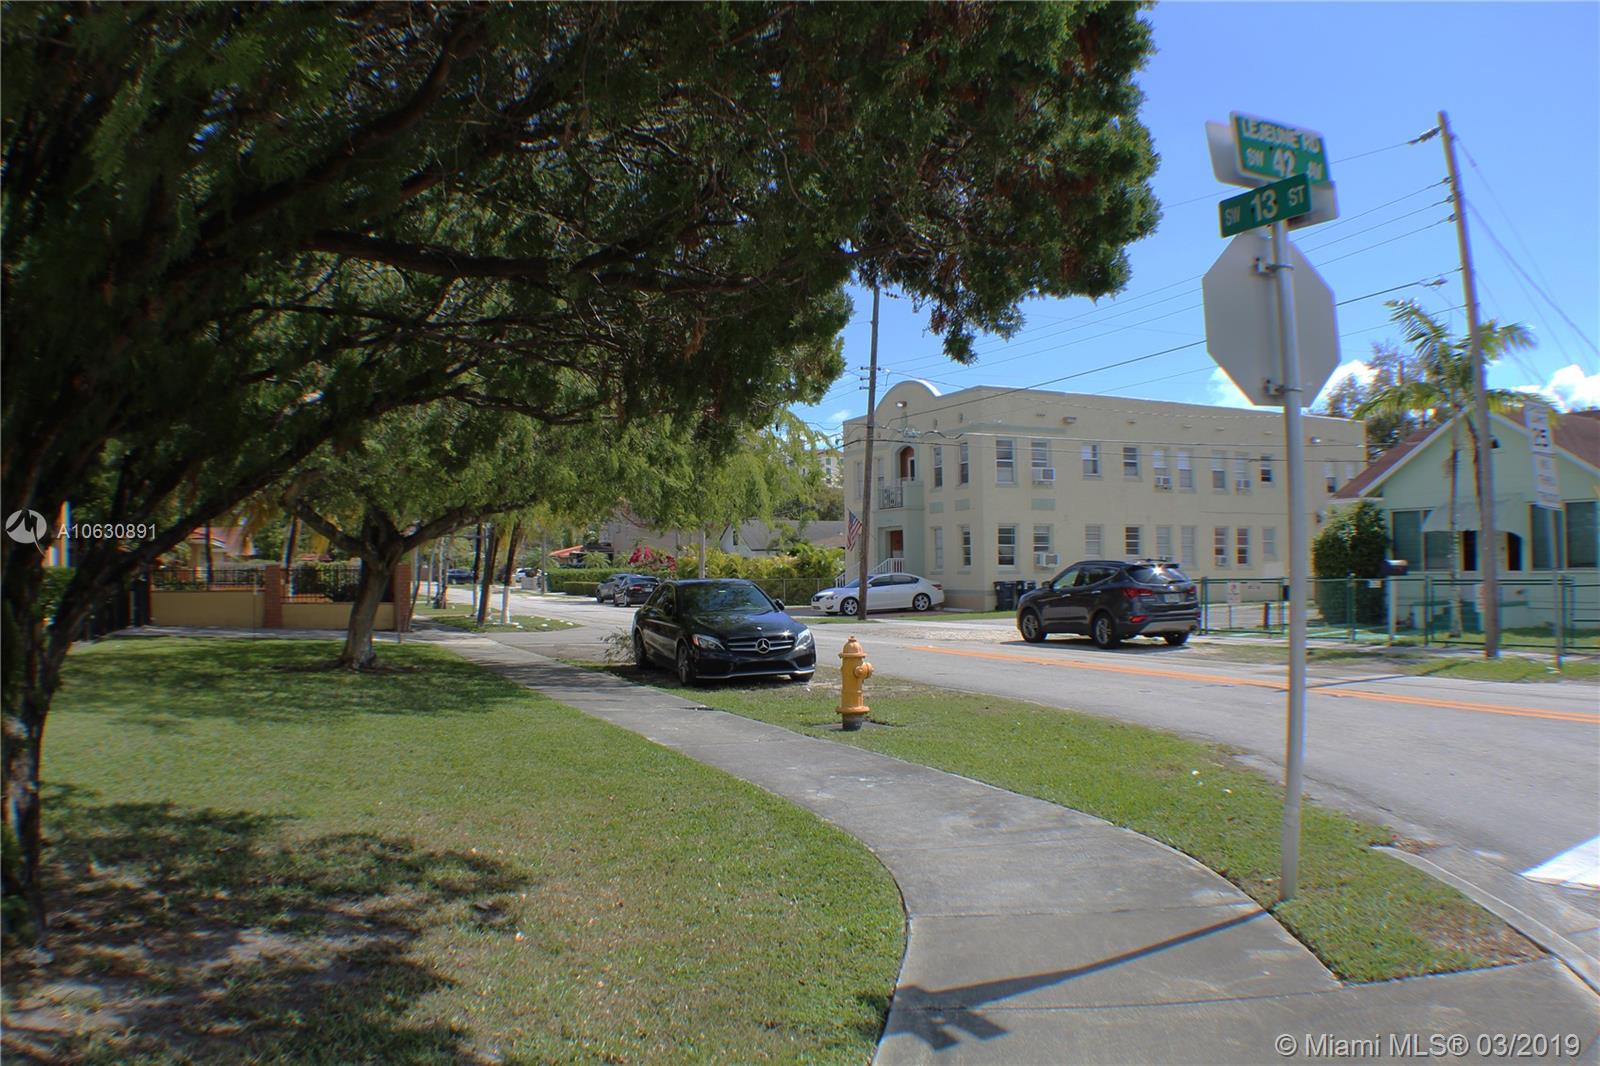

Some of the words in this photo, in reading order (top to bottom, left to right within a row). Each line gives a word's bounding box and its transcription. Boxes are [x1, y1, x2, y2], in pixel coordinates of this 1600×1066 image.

[1246, 147, 1265, 167] SW
[1273, 148, 1297, 178] 42
[1225, 206, 1241, 226] SW
[1250, 189, 1279, 222] 13
[1288, 185, 1305, 207] ST
